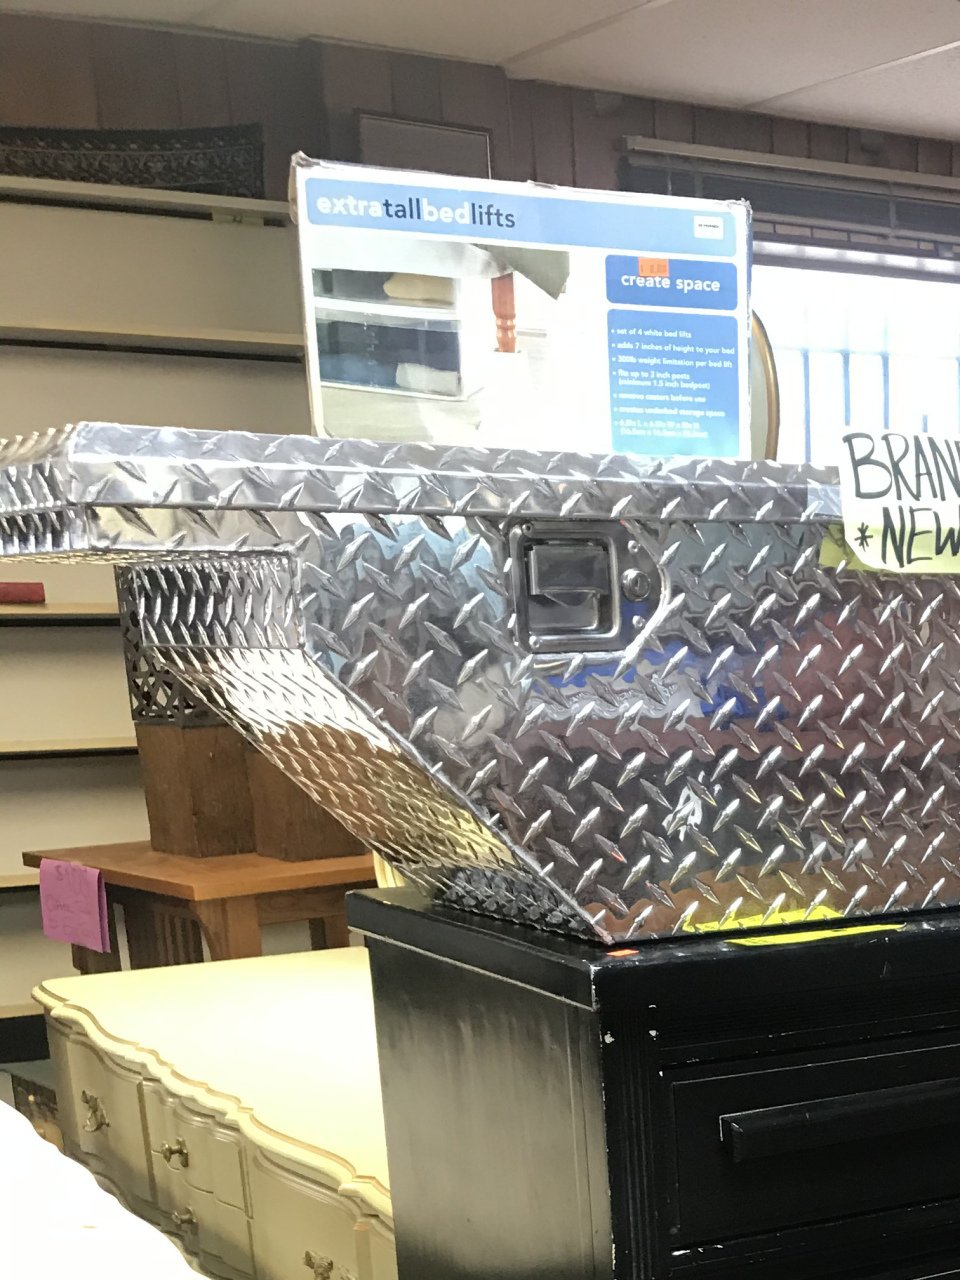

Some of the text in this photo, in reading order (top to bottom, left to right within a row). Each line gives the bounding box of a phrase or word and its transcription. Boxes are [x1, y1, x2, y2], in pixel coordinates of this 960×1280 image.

[316, 194, 516, 229] extratallbedlifts
[621, 275, 721, 293] create space
[664, 343, 671, 351] of
[673, 344, 694, 353] height
[722, 347, 735, 355] bed
[662, 358, 694, 366] limitation
